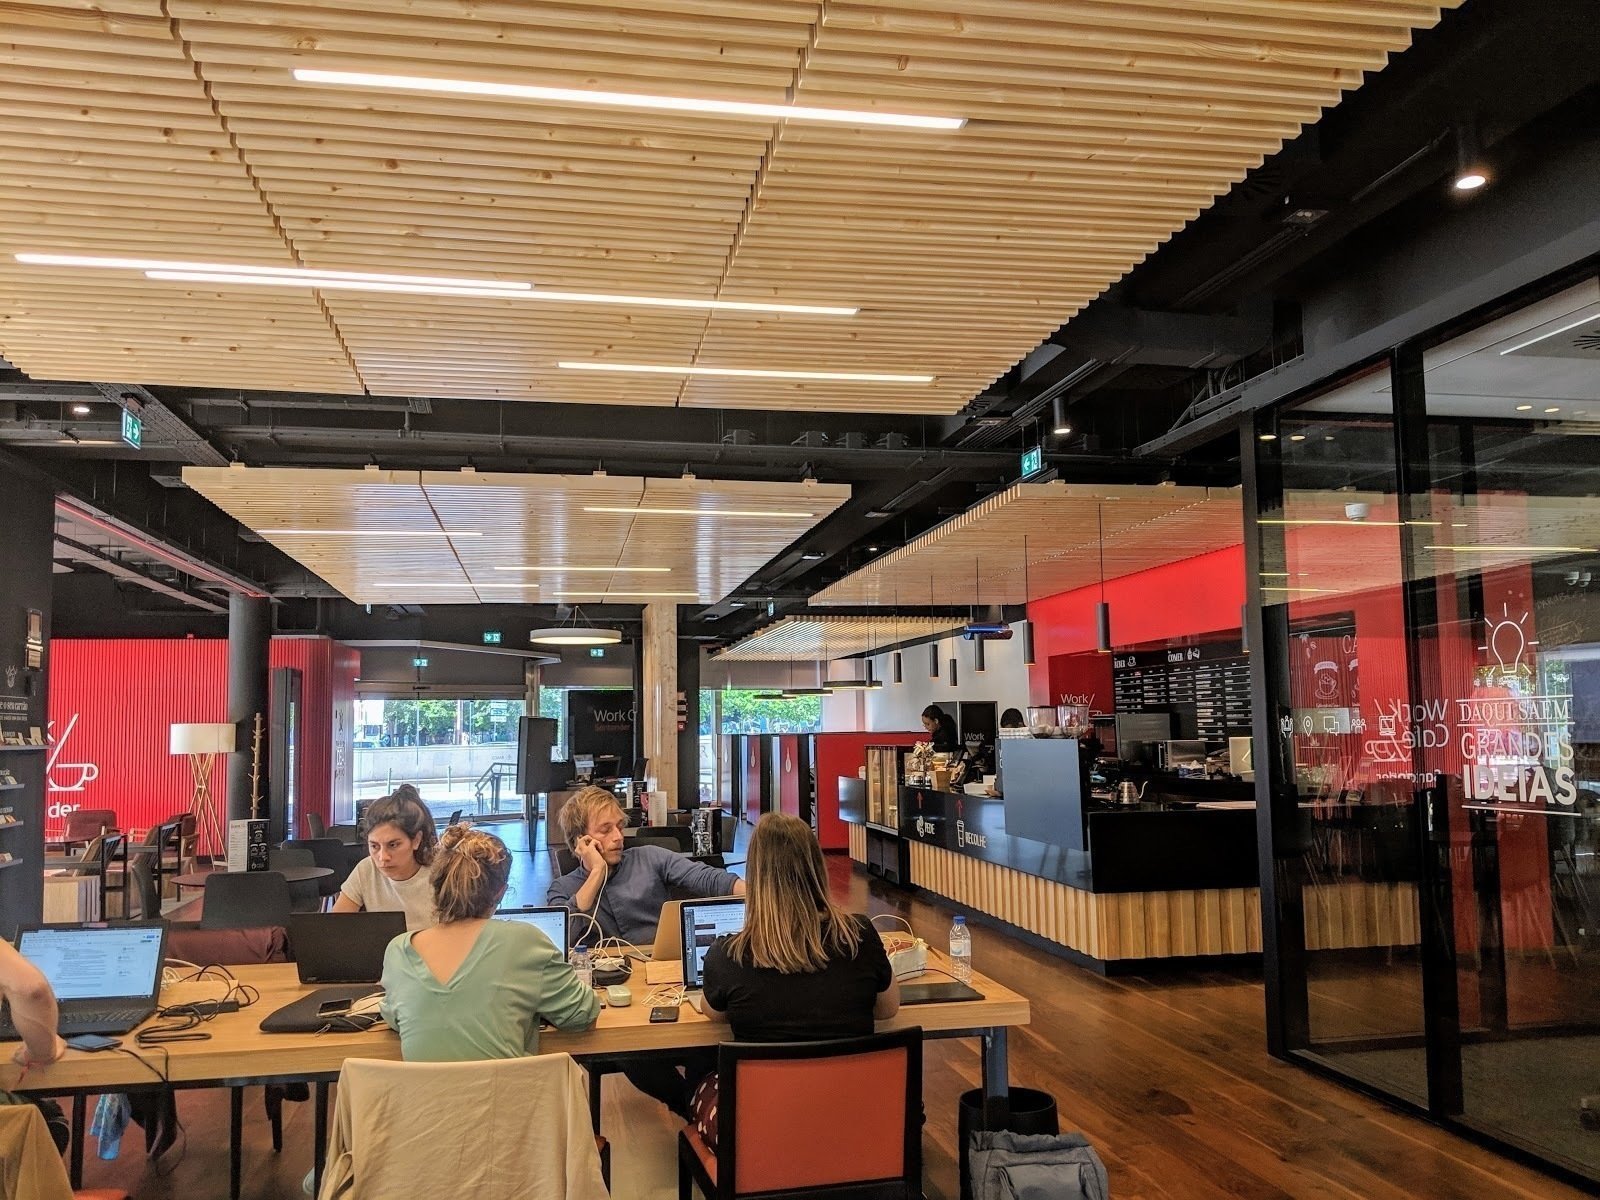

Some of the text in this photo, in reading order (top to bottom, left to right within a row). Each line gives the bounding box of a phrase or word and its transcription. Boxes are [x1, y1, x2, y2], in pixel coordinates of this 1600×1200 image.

[1060, 693, 1089, 704] Work
[594, 709, 626, 722] Work
[1459, 700, 1570, 726] DAQUI SAEM
[964, 733, 985, 742] Work
[1461, 731, 1574, 761] GRANDES
[1463, 764, 1577, 806] IDEIAS
[925, 822, 936, 835] PEDE
[965, 832, 987, 849] RECOLHE
